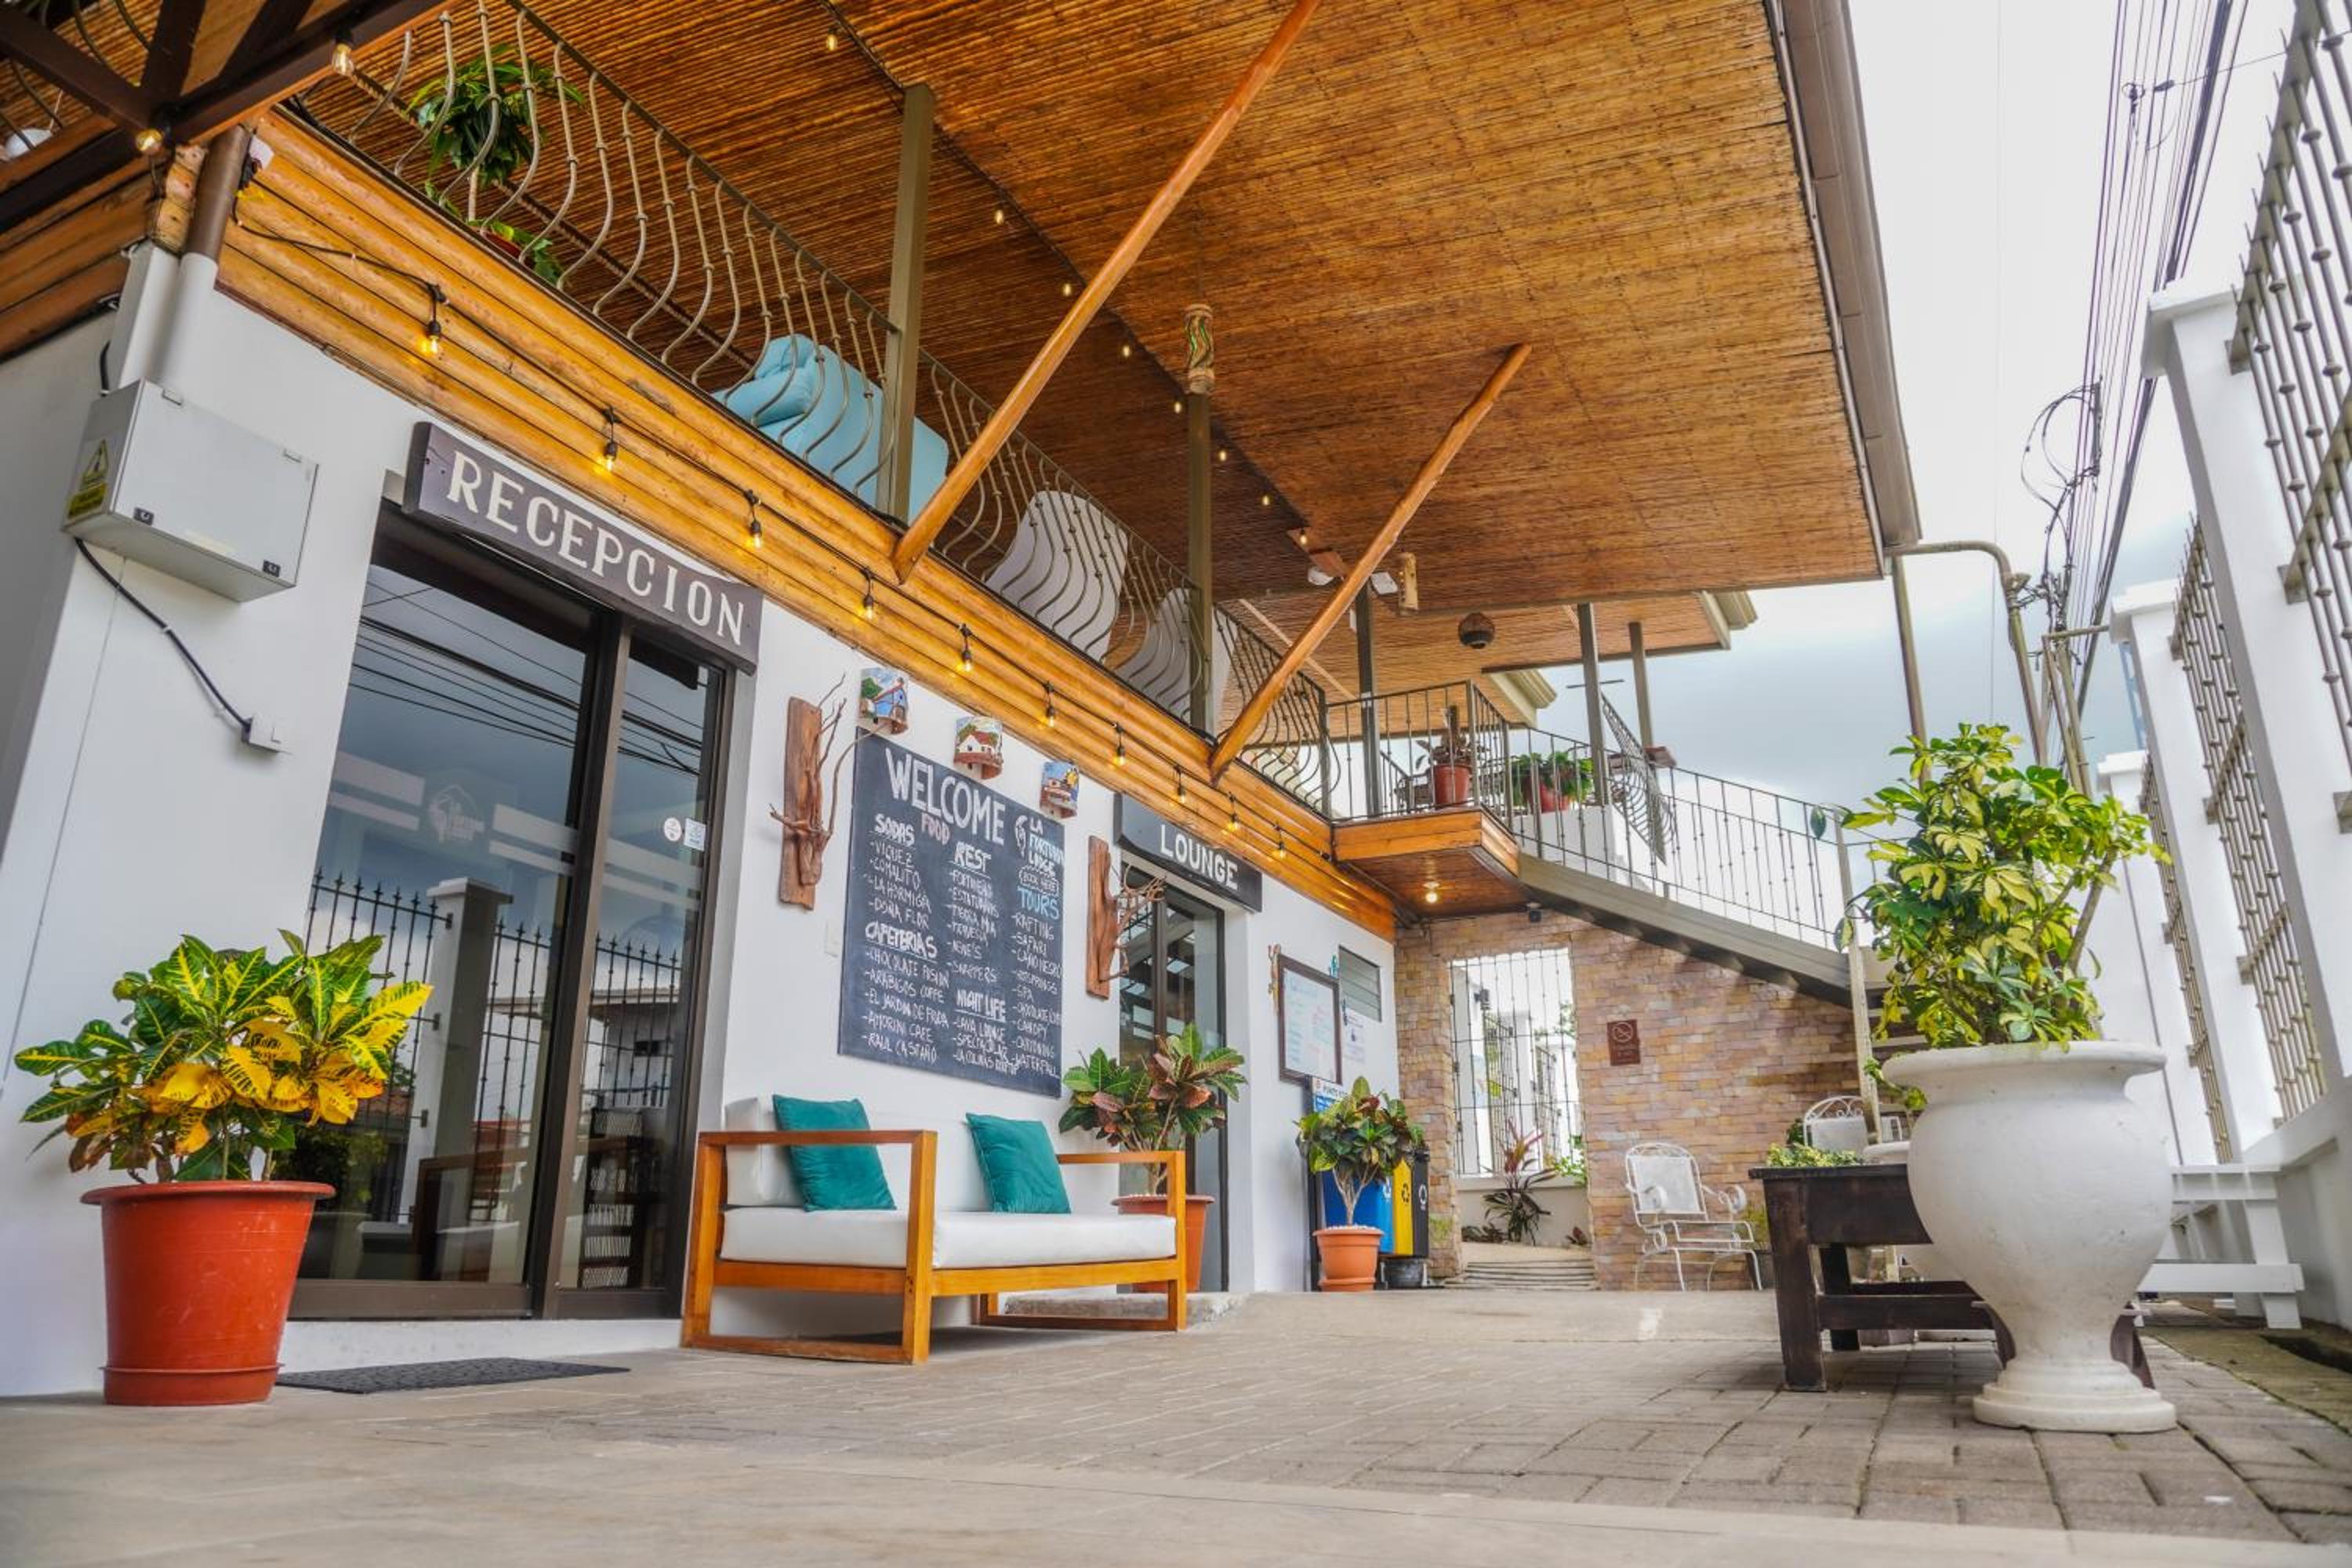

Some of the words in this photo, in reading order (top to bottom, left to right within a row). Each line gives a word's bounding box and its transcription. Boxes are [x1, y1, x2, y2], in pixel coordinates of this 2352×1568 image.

[446, 450, 743, 646] RECEPCION
[886, 748, 1006, 845] WELCOME
[874, 813, 916, 847] SODAS
[921, 811, 950, 846] FOOD
[1029, 816, 1044, 836] LA
[954, 841, 992, 873] REST
[1160, 824, 1238, 891] LOUNGE
[1017, 884, 1060, 920] TOURS
[865, 920, 938, 960] CAFETERIAS
[956, 989, 984, 1013] NIGHT
[985, 994, 1006, 1022] LIFE
